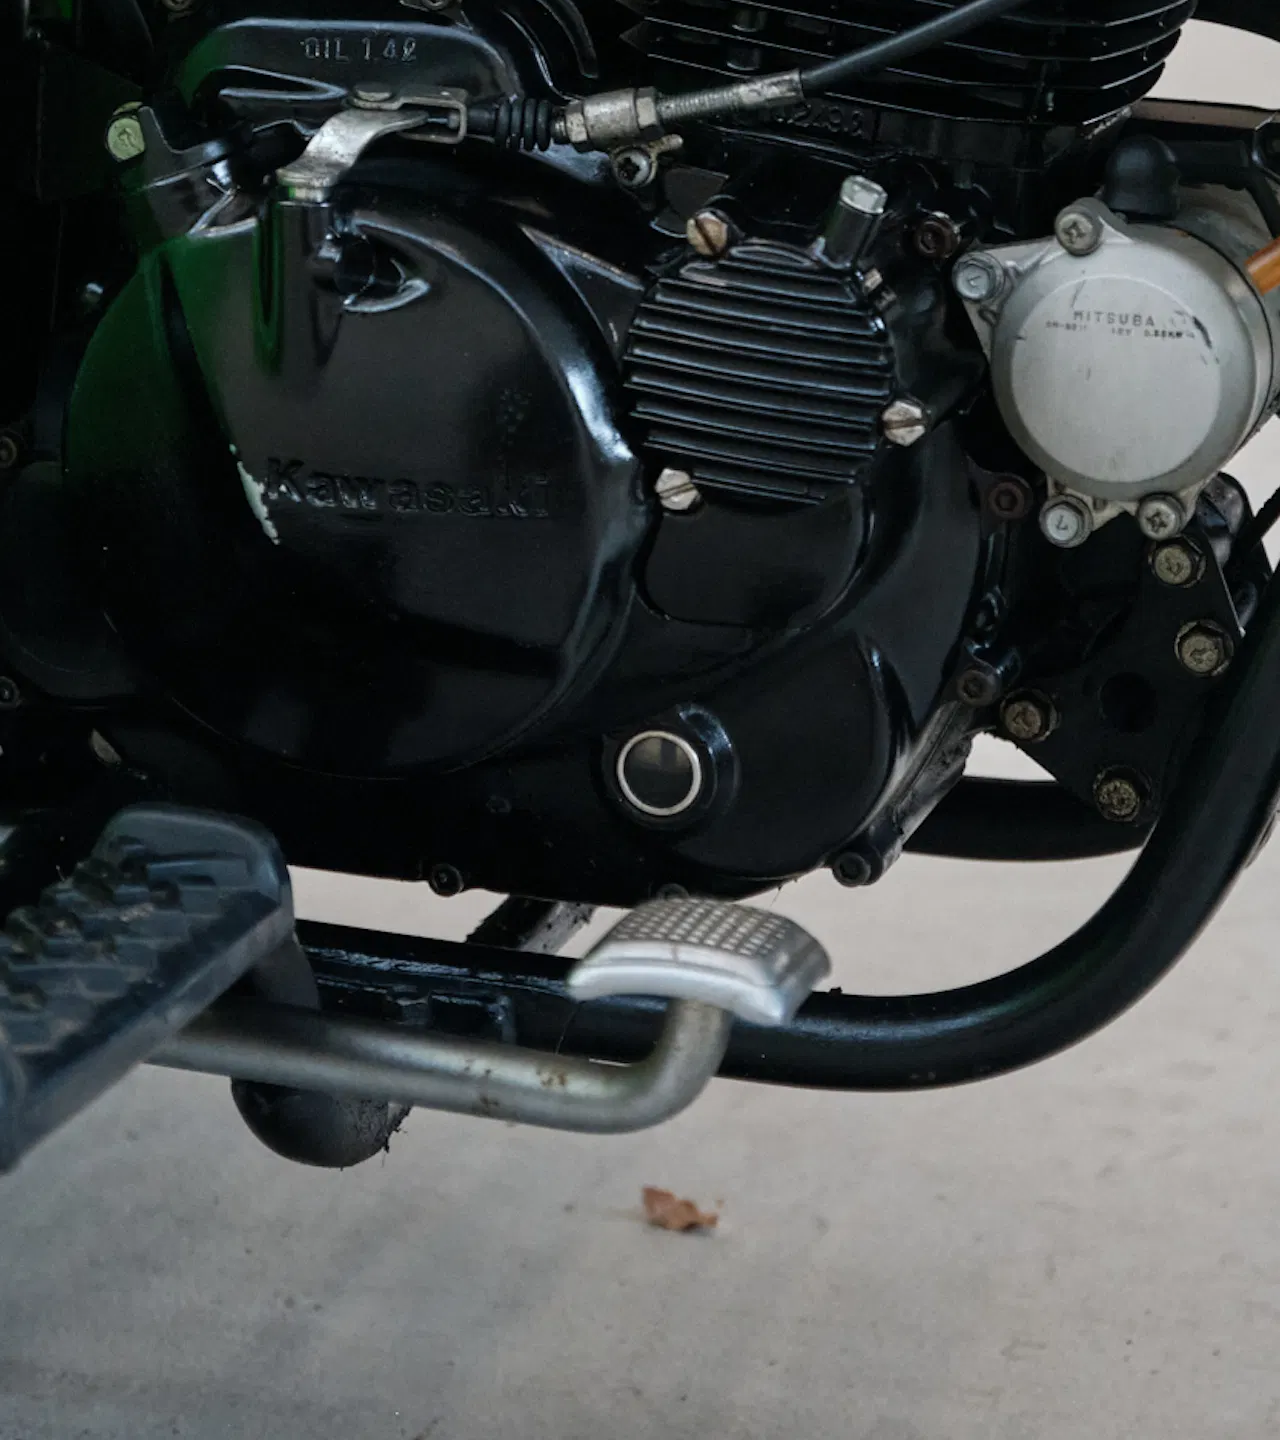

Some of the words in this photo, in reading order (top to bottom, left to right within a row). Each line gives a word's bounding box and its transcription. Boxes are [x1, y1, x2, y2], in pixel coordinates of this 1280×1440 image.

[303, 35, 352, 63] OIL
[1073, 309, 1156, 327] MITSUBA
[264, 456, 553, 519] Kawasaki
